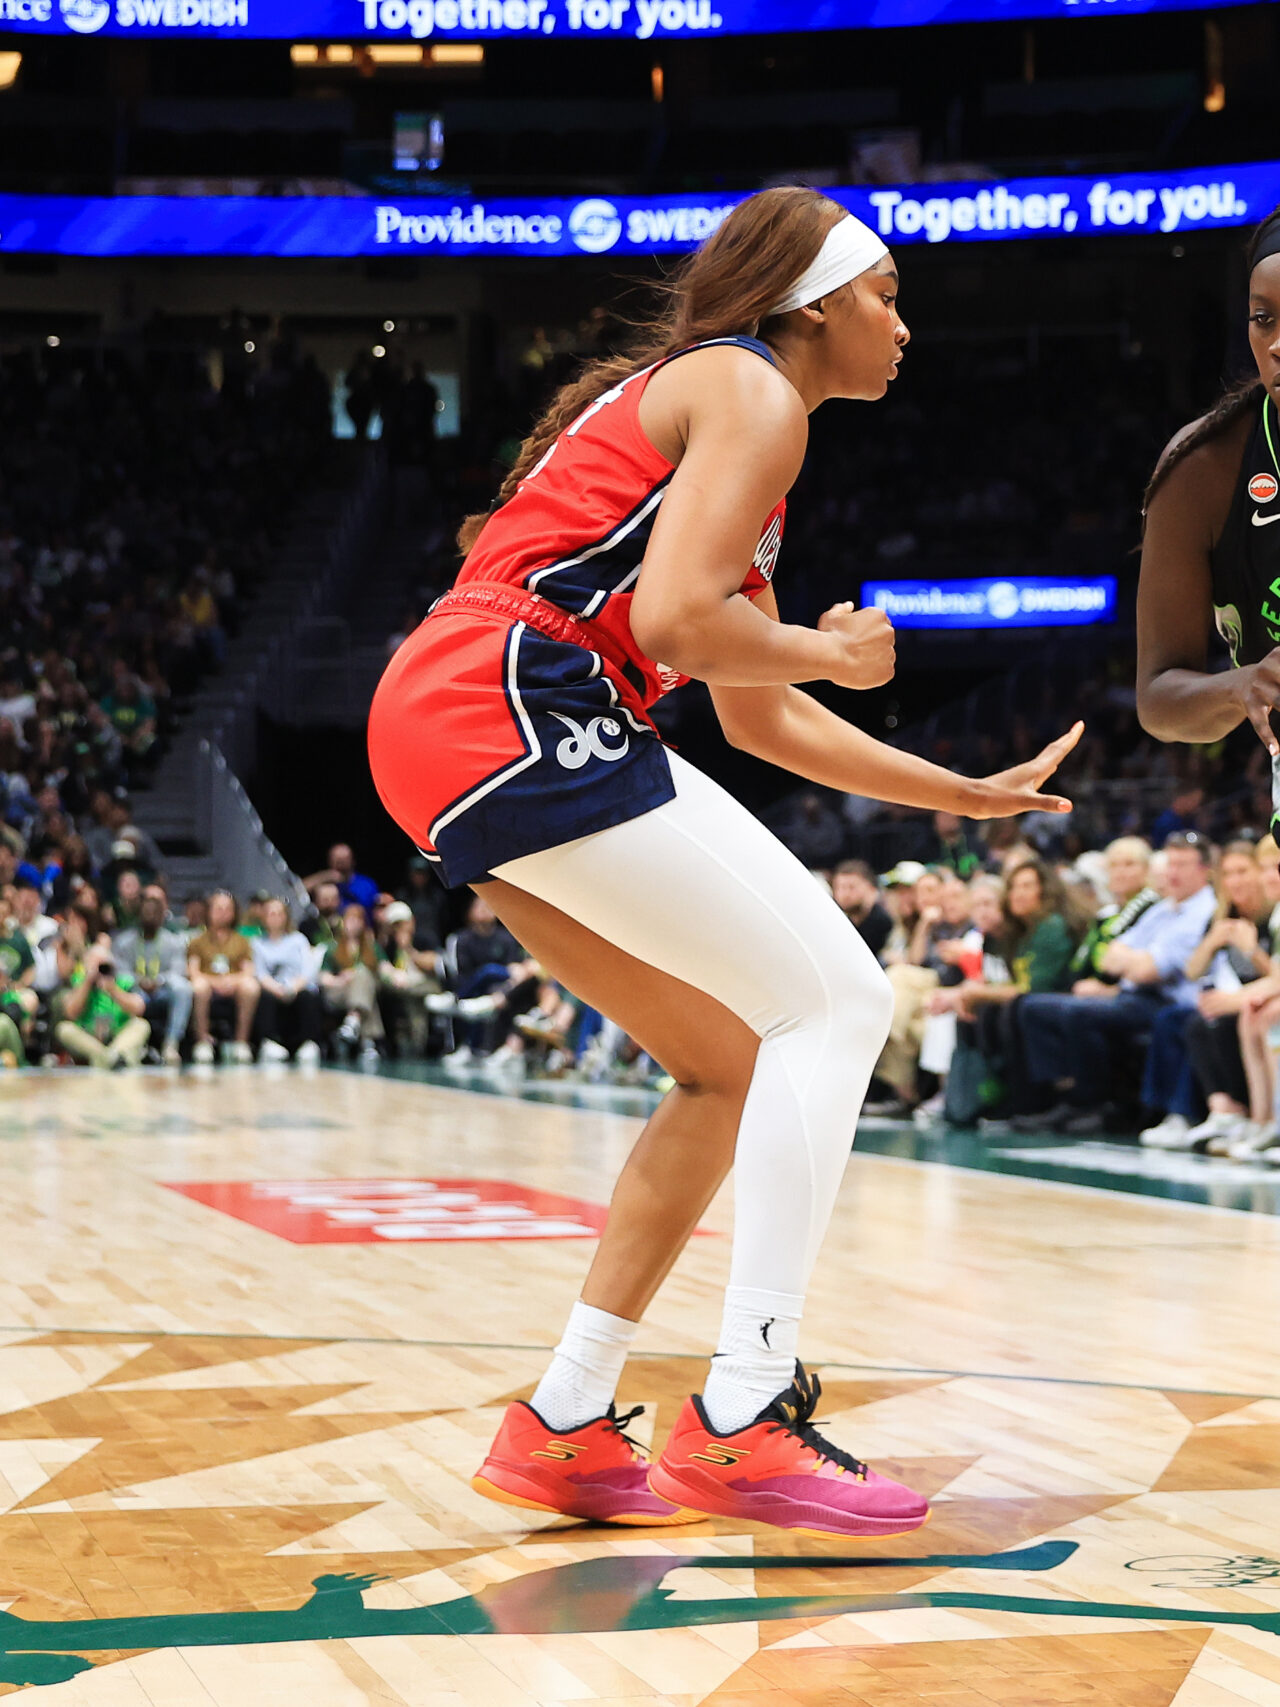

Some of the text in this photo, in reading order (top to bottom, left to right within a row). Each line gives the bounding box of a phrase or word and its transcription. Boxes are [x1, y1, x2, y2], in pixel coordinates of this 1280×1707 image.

[566, 0, 630, 29] for
[635, 0, 723, 39] you.
[374, 204, 563, 244] Providence
[868, 182, 1248, 243] Together, for you.
